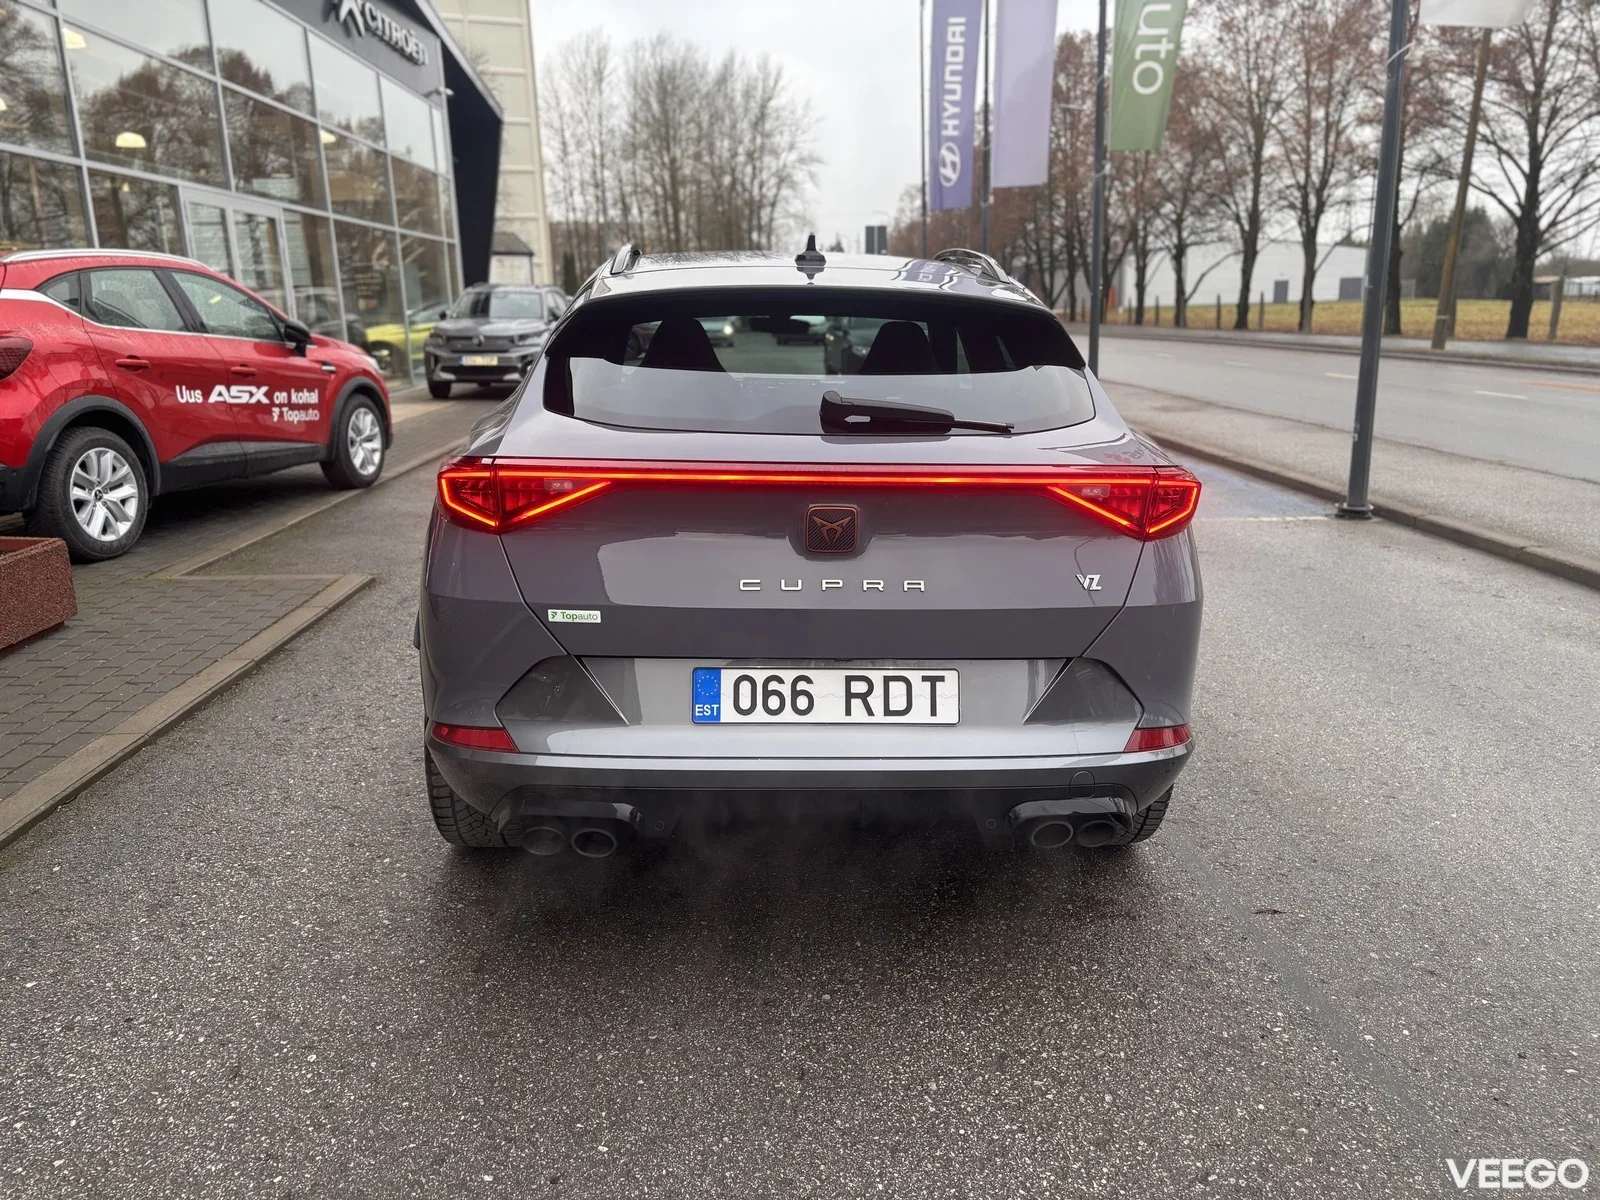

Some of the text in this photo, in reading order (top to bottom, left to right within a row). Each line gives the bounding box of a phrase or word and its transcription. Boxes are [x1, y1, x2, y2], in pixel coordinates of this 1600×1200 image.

[941, 16, 967, 137] HYUNDAI
[175, 384, 319, 404] Uus ASX on kohal
[282, 407, 320, 424] Topauto
[739, 579, 925, 592] CUPRA
[1076, 574, 1102, 591] VZ
[560, 611, 598, 621] Topauto
[733, 674, 945, 717] 066 RDT
[695, 704, 719, 716] EST
